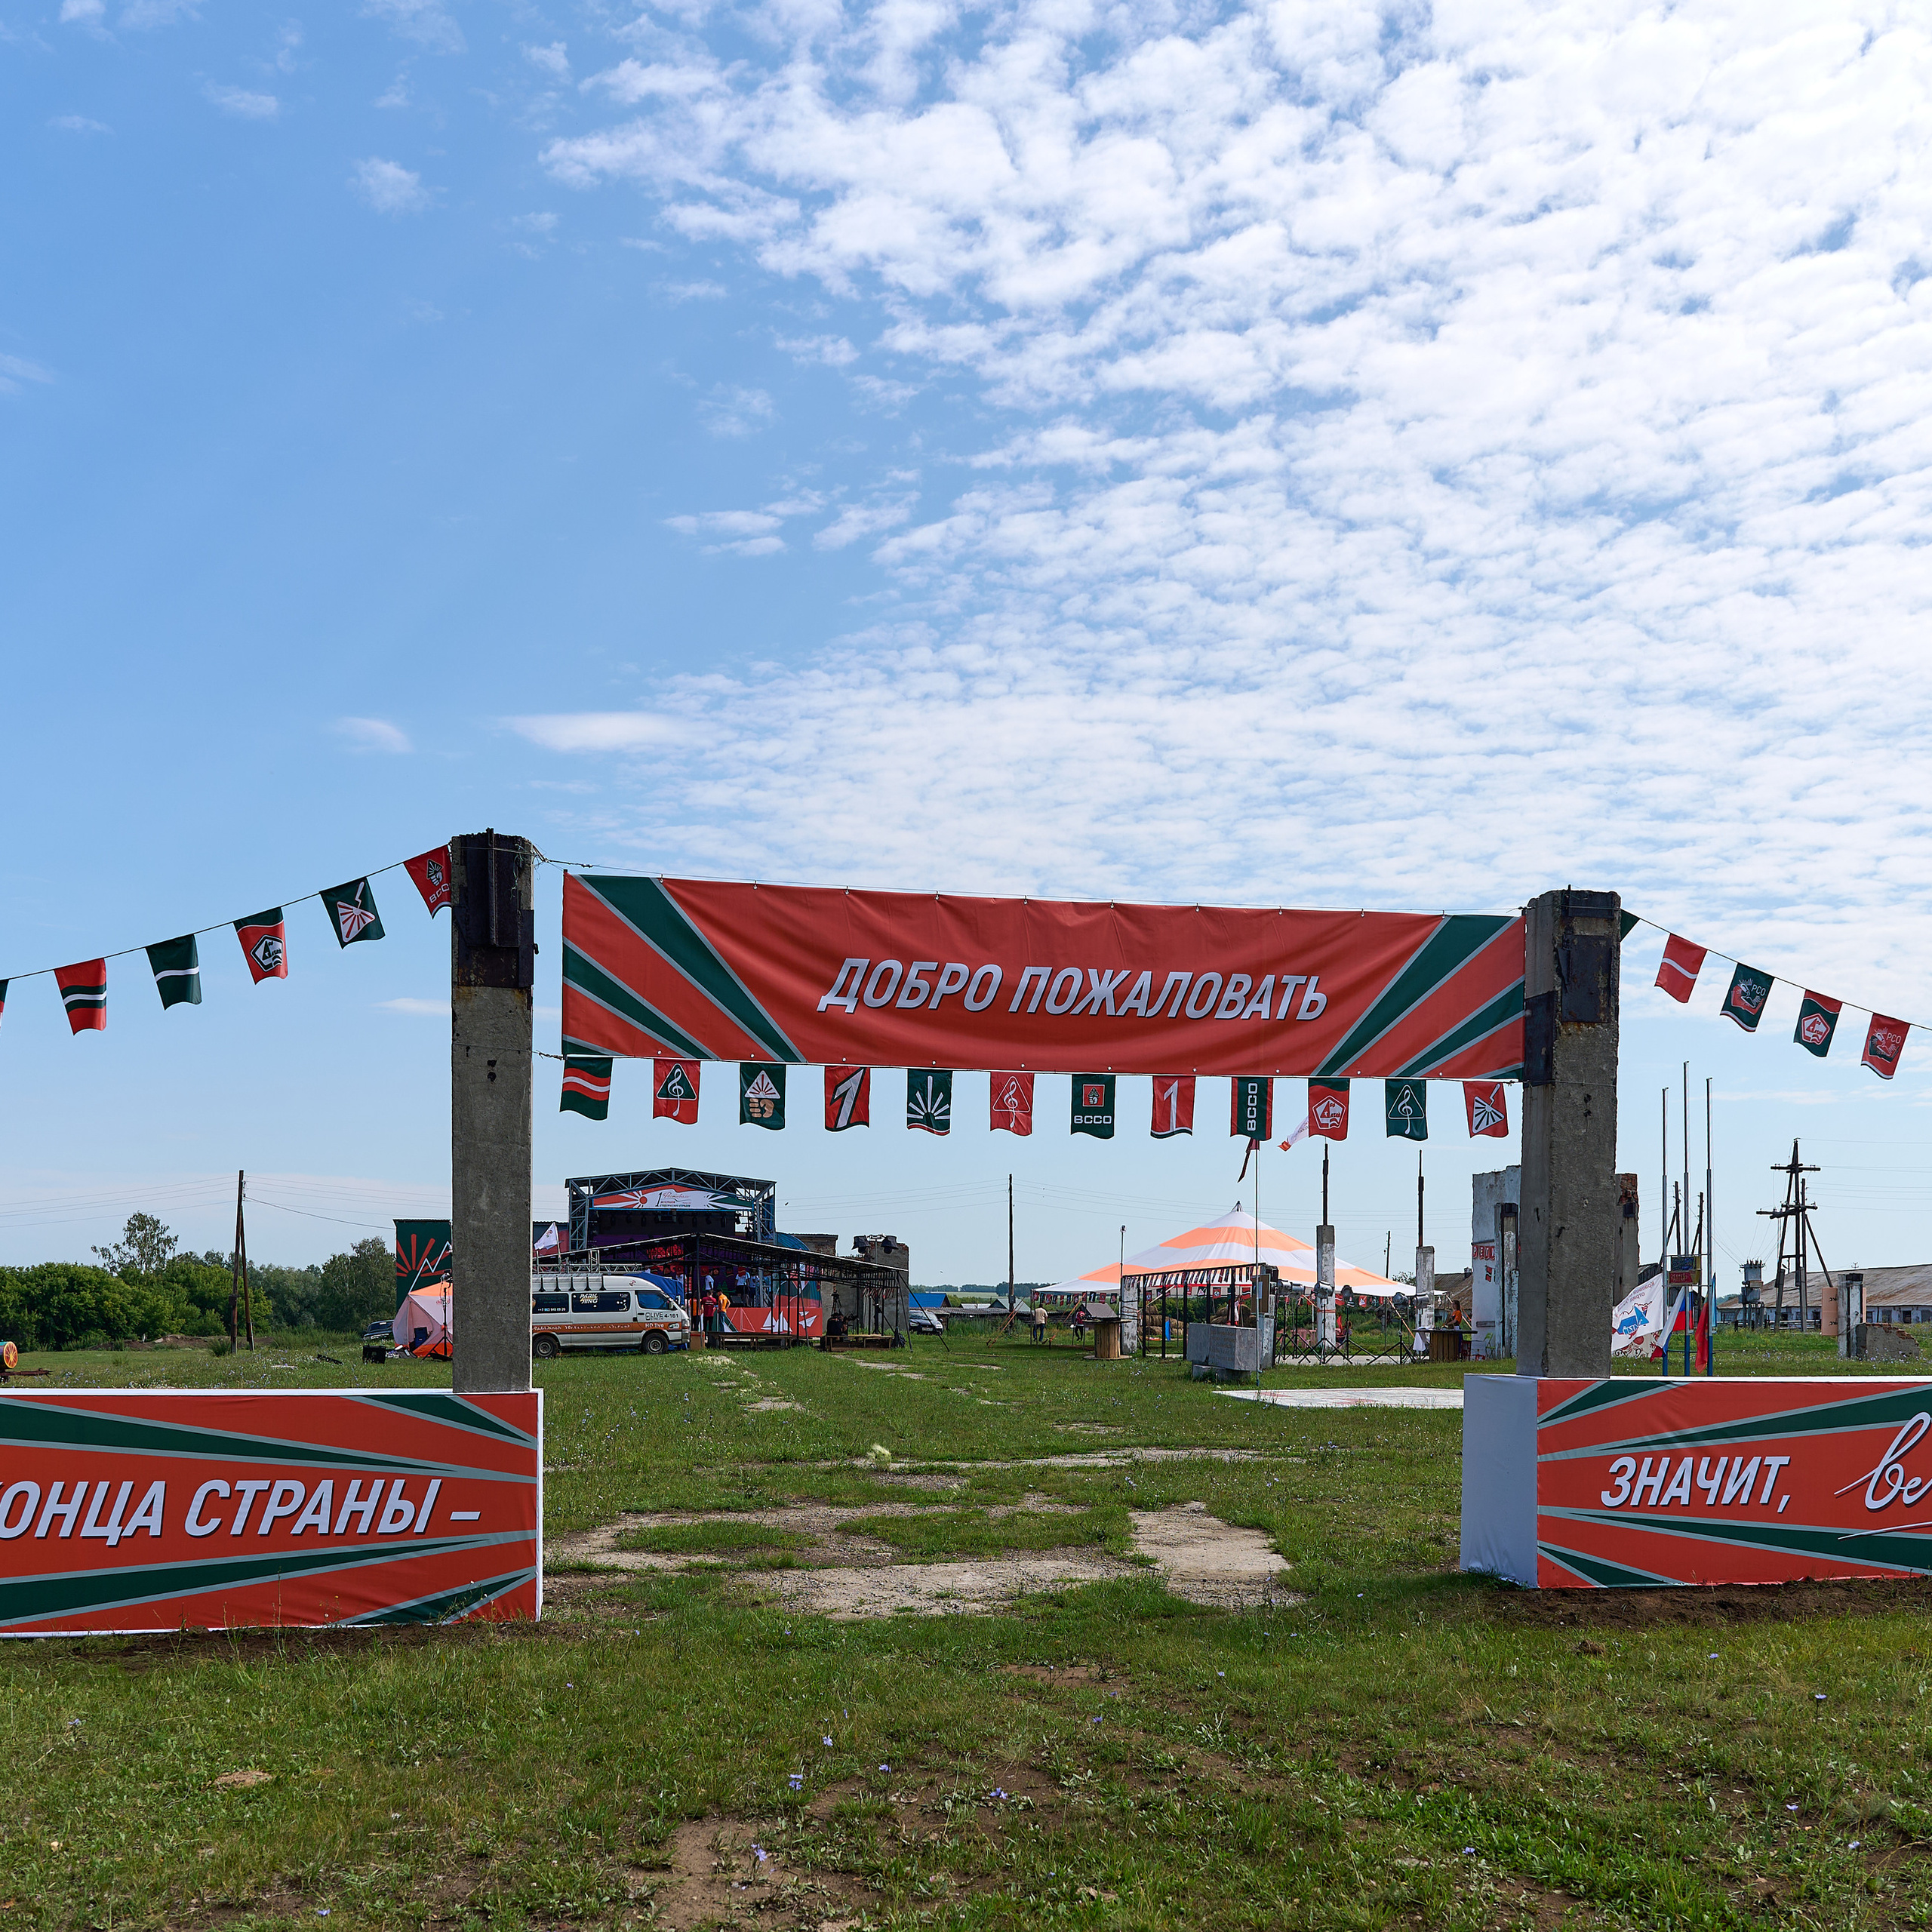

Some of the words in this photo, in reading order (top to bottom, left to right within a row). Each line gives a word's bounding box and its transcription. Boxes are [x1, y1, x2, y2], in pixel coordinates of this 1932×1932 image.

[817, 957, 1004, 1014] ДОБРО
[1008, 965, 1329, 1022] ПОЖАЛОВАТЬ
[1073, 1115, 1112, 1126] ВССО
[1246, 1082, 1258, 1132] ВССО
[0, 1479, 166, 1546] ОНЦА
[183, 1478, 443, 1538] СТРАНЫ
[1600, 1455, 1791, 1514] ЗНАЧИТ,
